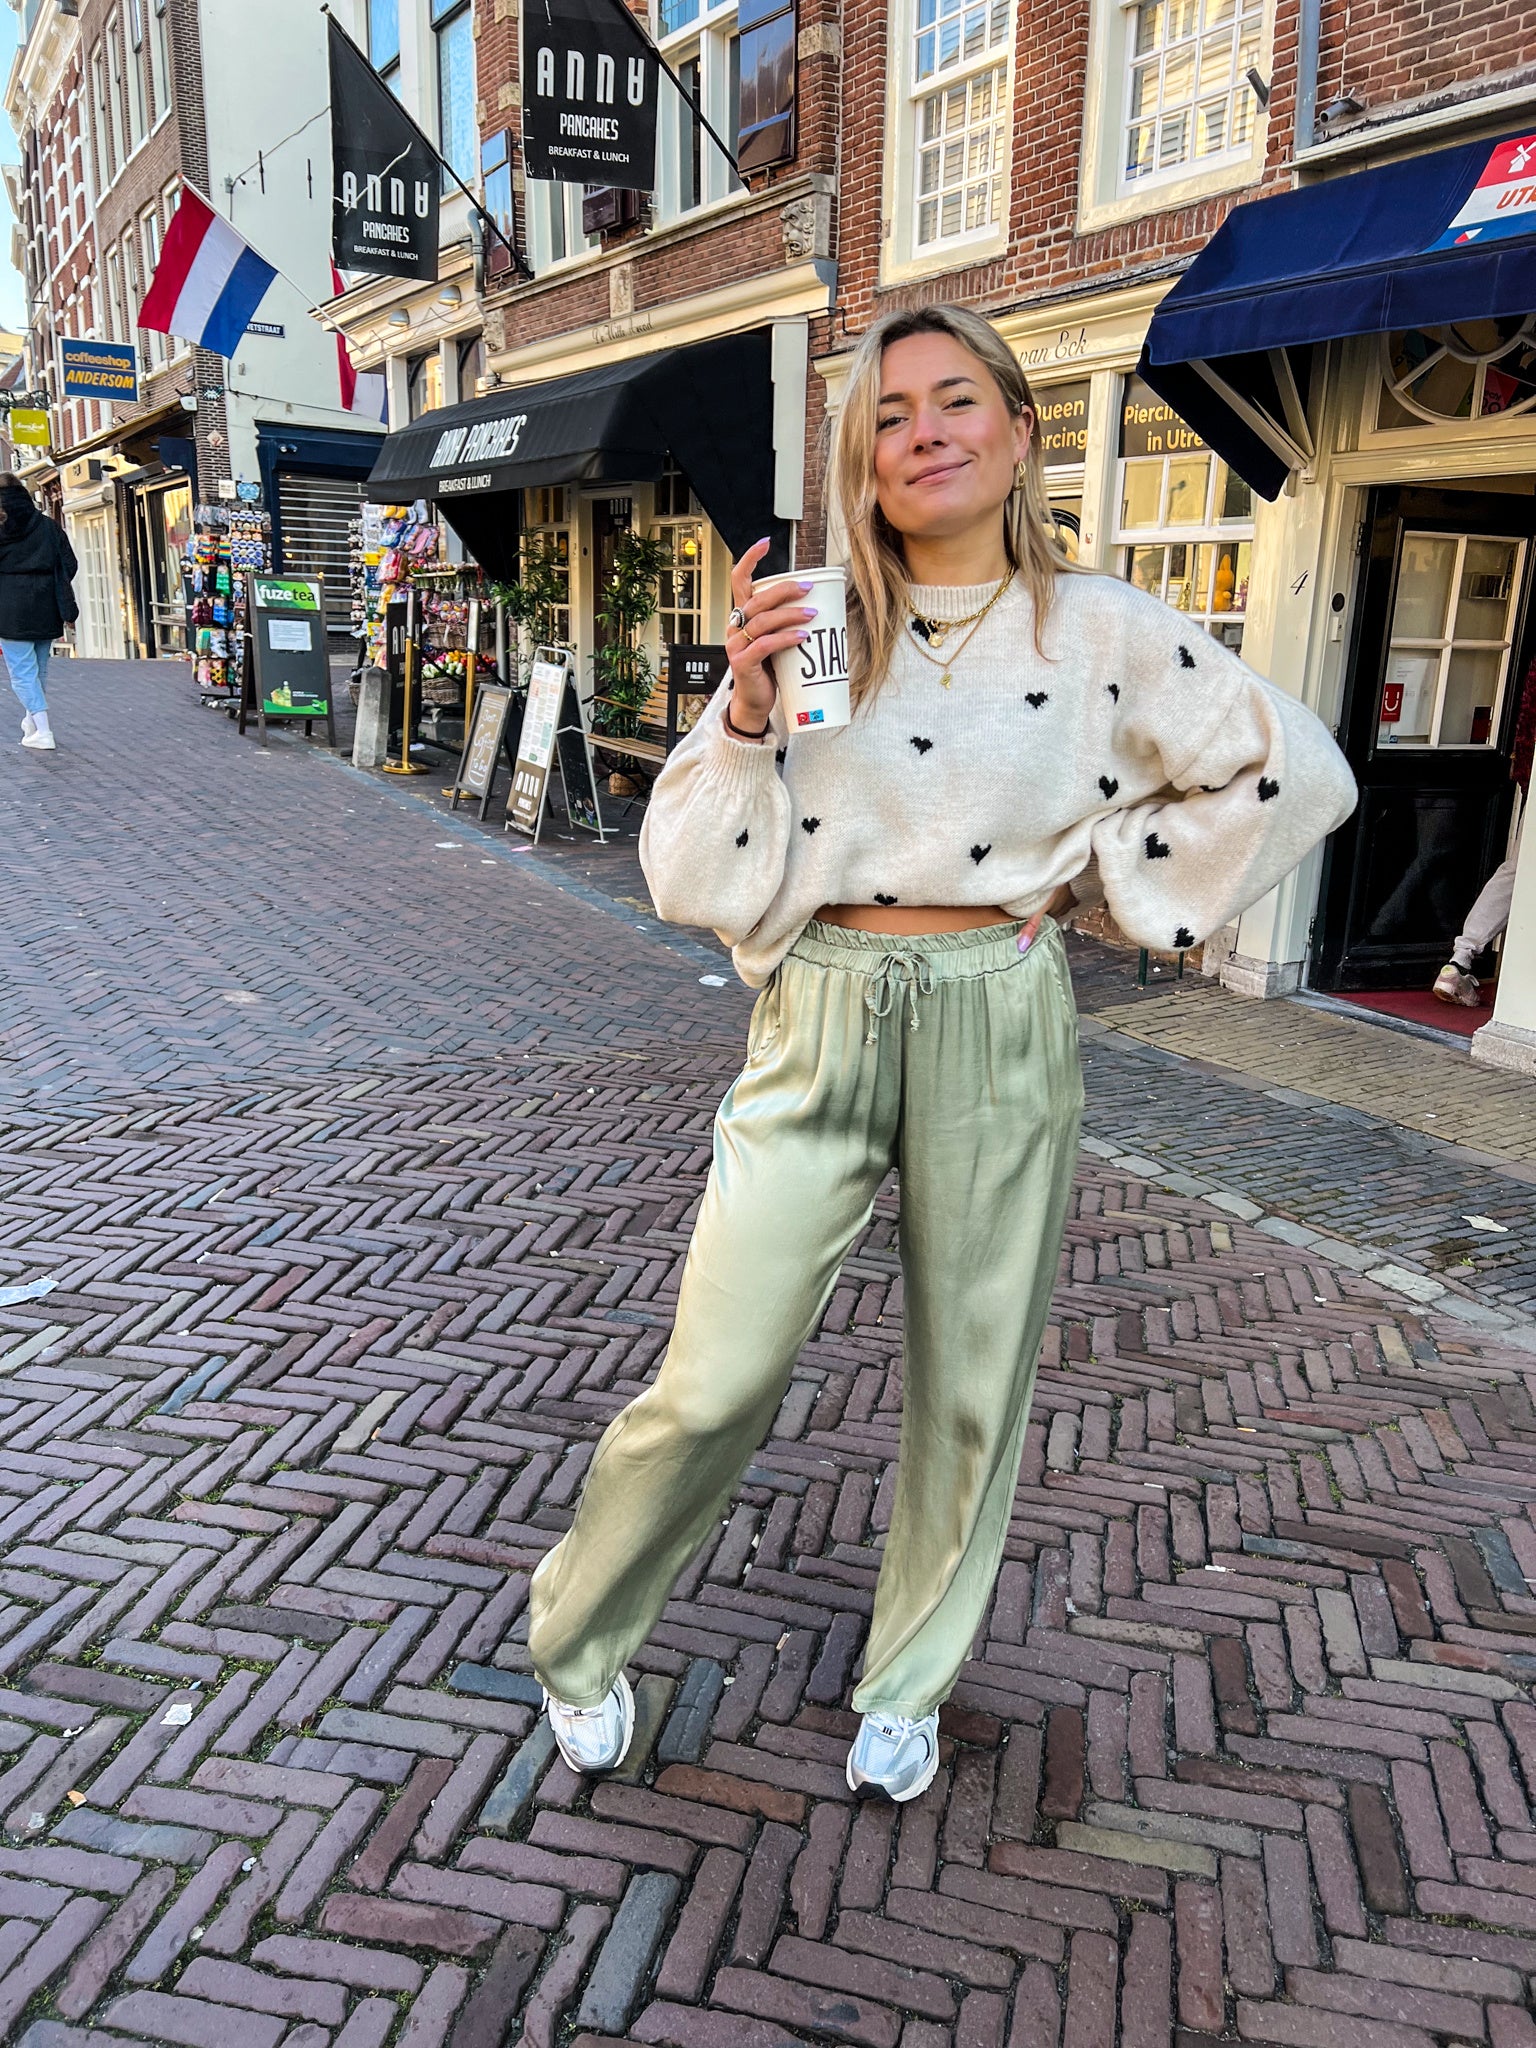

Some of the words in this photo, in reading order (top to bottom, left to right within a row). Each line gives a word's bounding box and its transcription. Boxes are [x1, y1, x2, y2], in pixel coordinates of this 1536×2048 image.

[560, 113, 619, 140] PANCAKES
[548, 145, 592, 159] BREAKFAST
[593, 150, 600, 160] &
[602, 153, 629, 163] LUNCH
[362, 221, 410, 243] PANCAKES
[353, 245, 390, 256] BREAKFAST
[390, 249, 396, 258] &
[397, 251, 418, 260] LUNCH
[1019, 347, 1048, 365] van
[1055, 328, 1087, 359] Eck
[65, 352, 131, 369] coffeeshop
[66, 369, 134, 389] ANDERSOM
[458, 414, 528, 464] PANCAKES
[1147, 430, 1162, 452] in
[438, 477, 467, 493] BREAKFAST
[472, 474, 491, 489] LUNCH
[1290, 570, 1308, 595] 4
